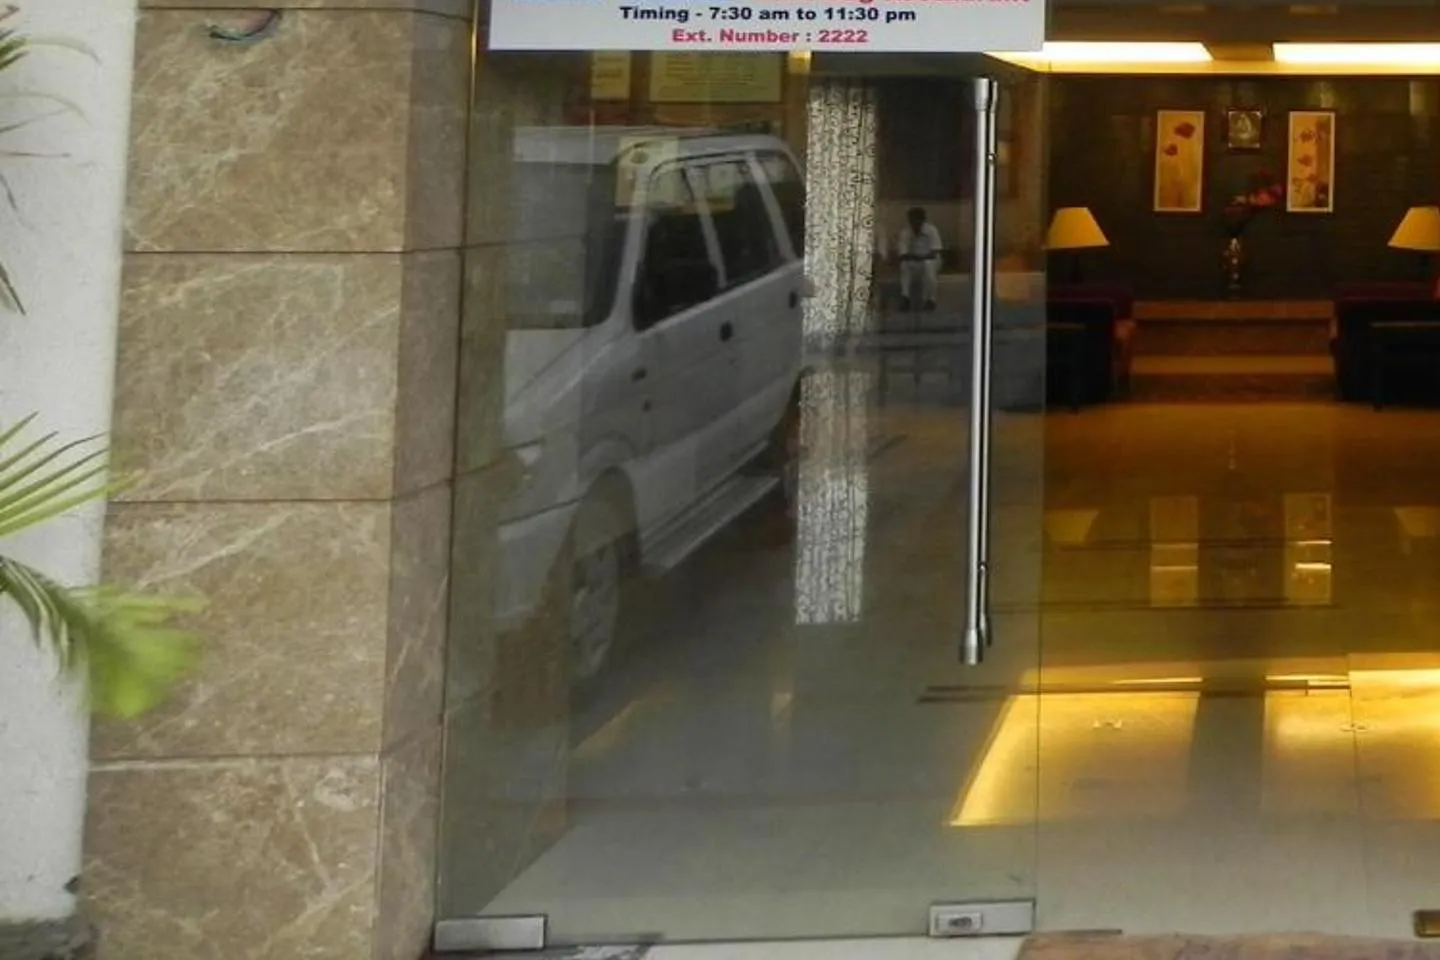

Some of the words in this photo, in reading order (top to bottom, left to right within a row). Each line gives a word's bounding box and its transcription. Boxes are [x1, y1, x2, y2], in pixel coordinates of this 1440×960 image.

[619, 5, 690, 22] Timing
[709, 6, 752, 21] 7:30
[758, 10, 790, 21] am
[796, 7, 817, 21] to
[824, 6, 879, 21] 11:30
[885, 10, 916, 24] pm
[671, 28, 712, 43] Ext.
[719, 28, 799, 43] Number
[818, 29, 868, 44] 2222
